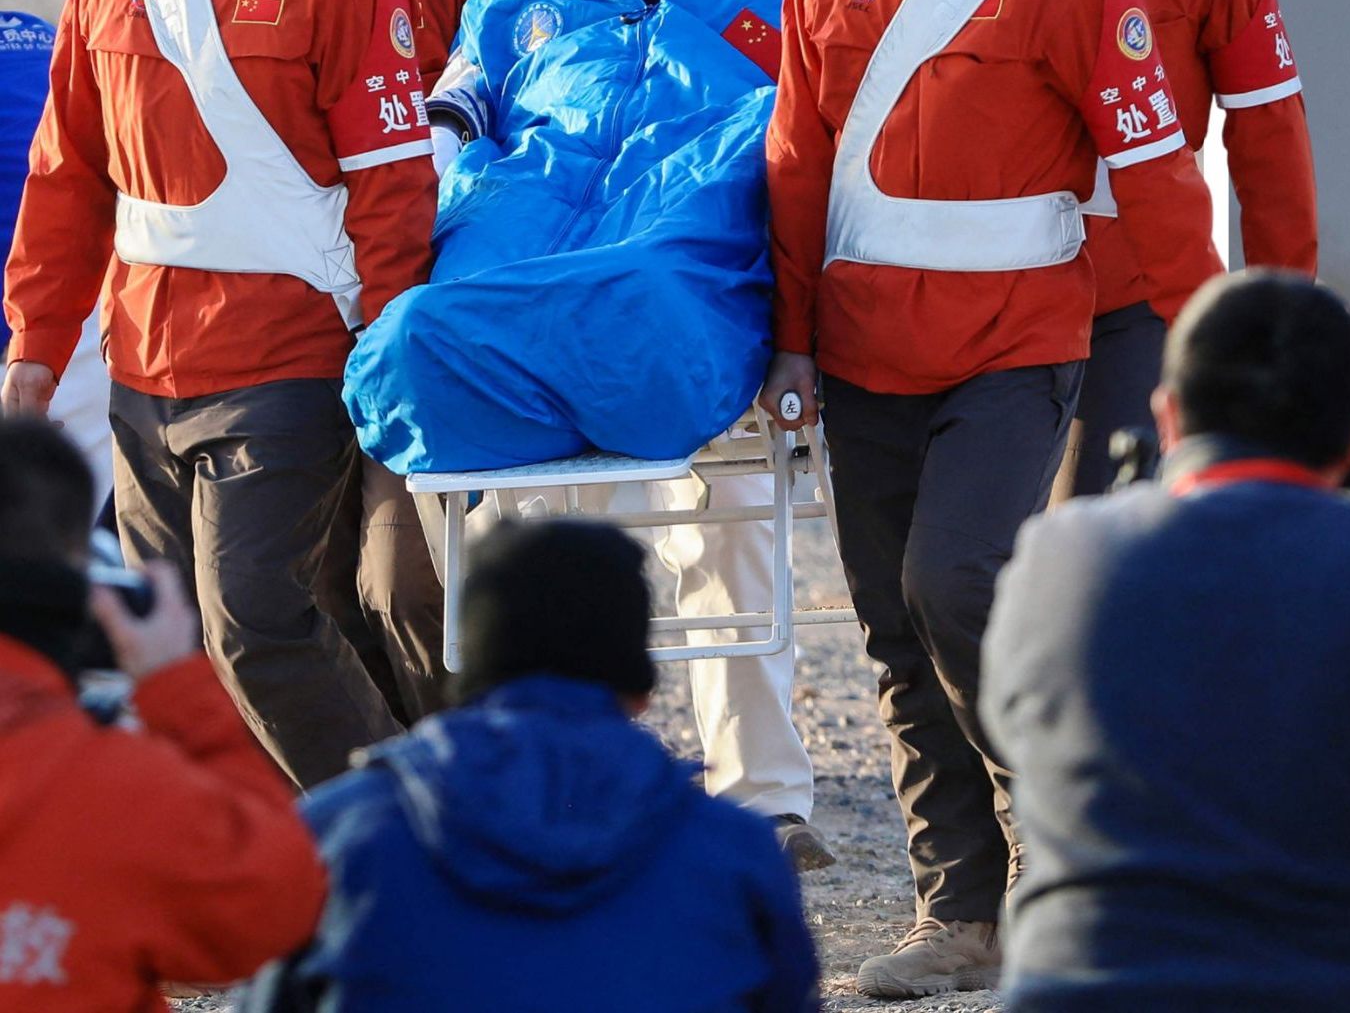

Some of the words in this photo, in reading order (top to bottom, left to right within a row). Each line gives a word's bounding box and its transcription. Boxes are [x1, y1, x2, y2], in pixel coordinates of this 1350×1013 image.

[378, 91, 430, 134] 处置
[1116, 89, 1177, 143] 处置
[784, 400, 798, 413] 左
